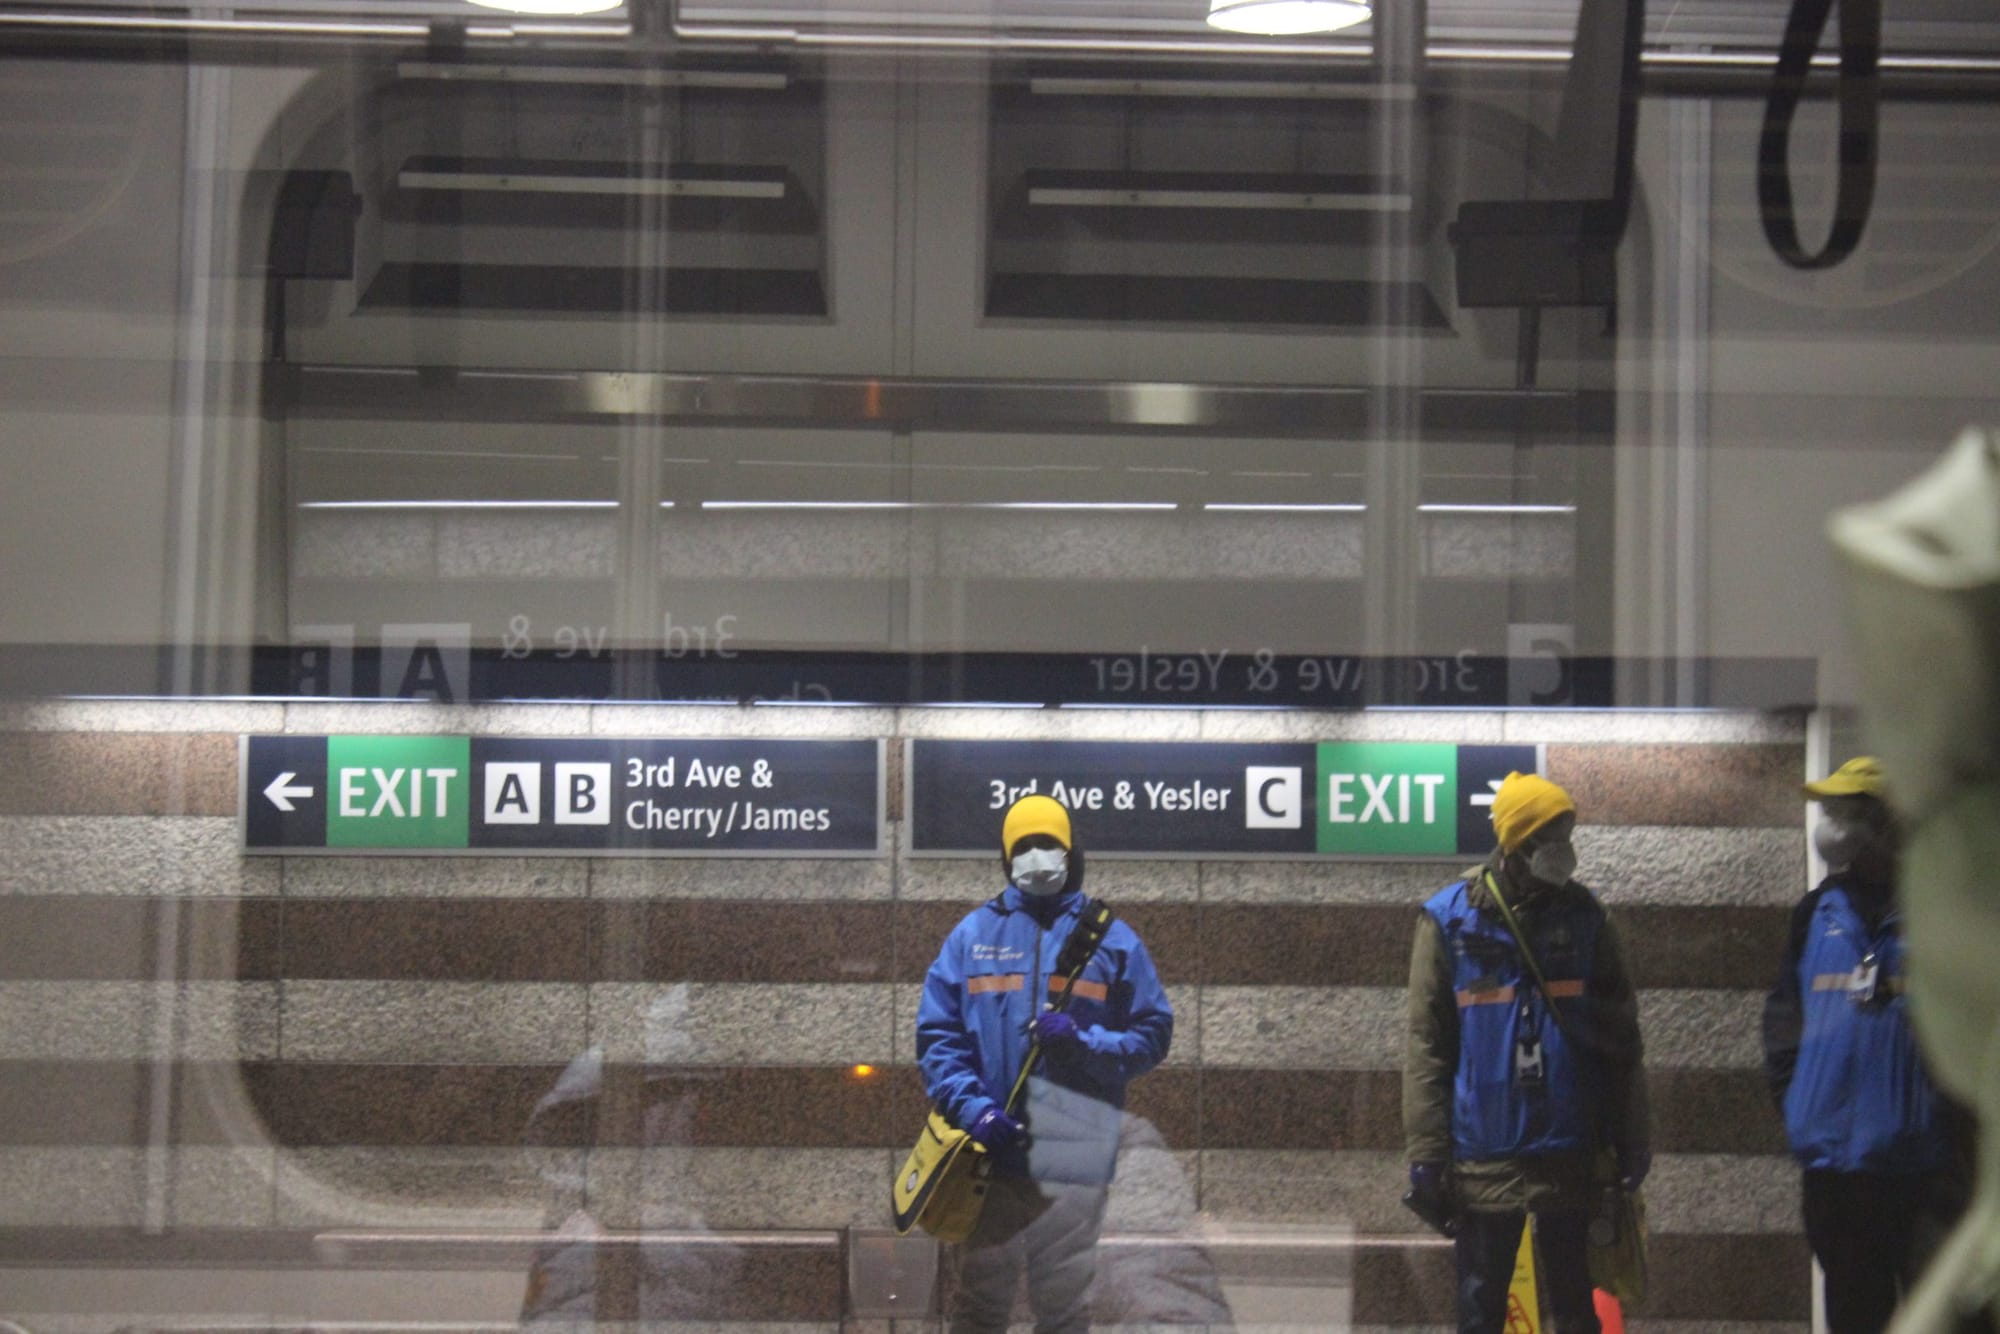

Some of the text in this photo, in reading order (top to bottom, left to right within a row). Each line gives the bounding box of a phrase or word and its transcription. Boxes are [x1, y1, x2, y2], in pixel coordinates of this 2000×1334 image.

[339, 767, 596, 818] EXIT A B
[625, 756, 774, 788] 3rd Ave &
[1050, 779, 1104, 810] Ave
[1113, 780, 1136, 811] &
[1143, 779, 1232, 811] Yesler
[1258, 777, 1287, 818] C
[1328, 773, 1445, 824] EXIT
